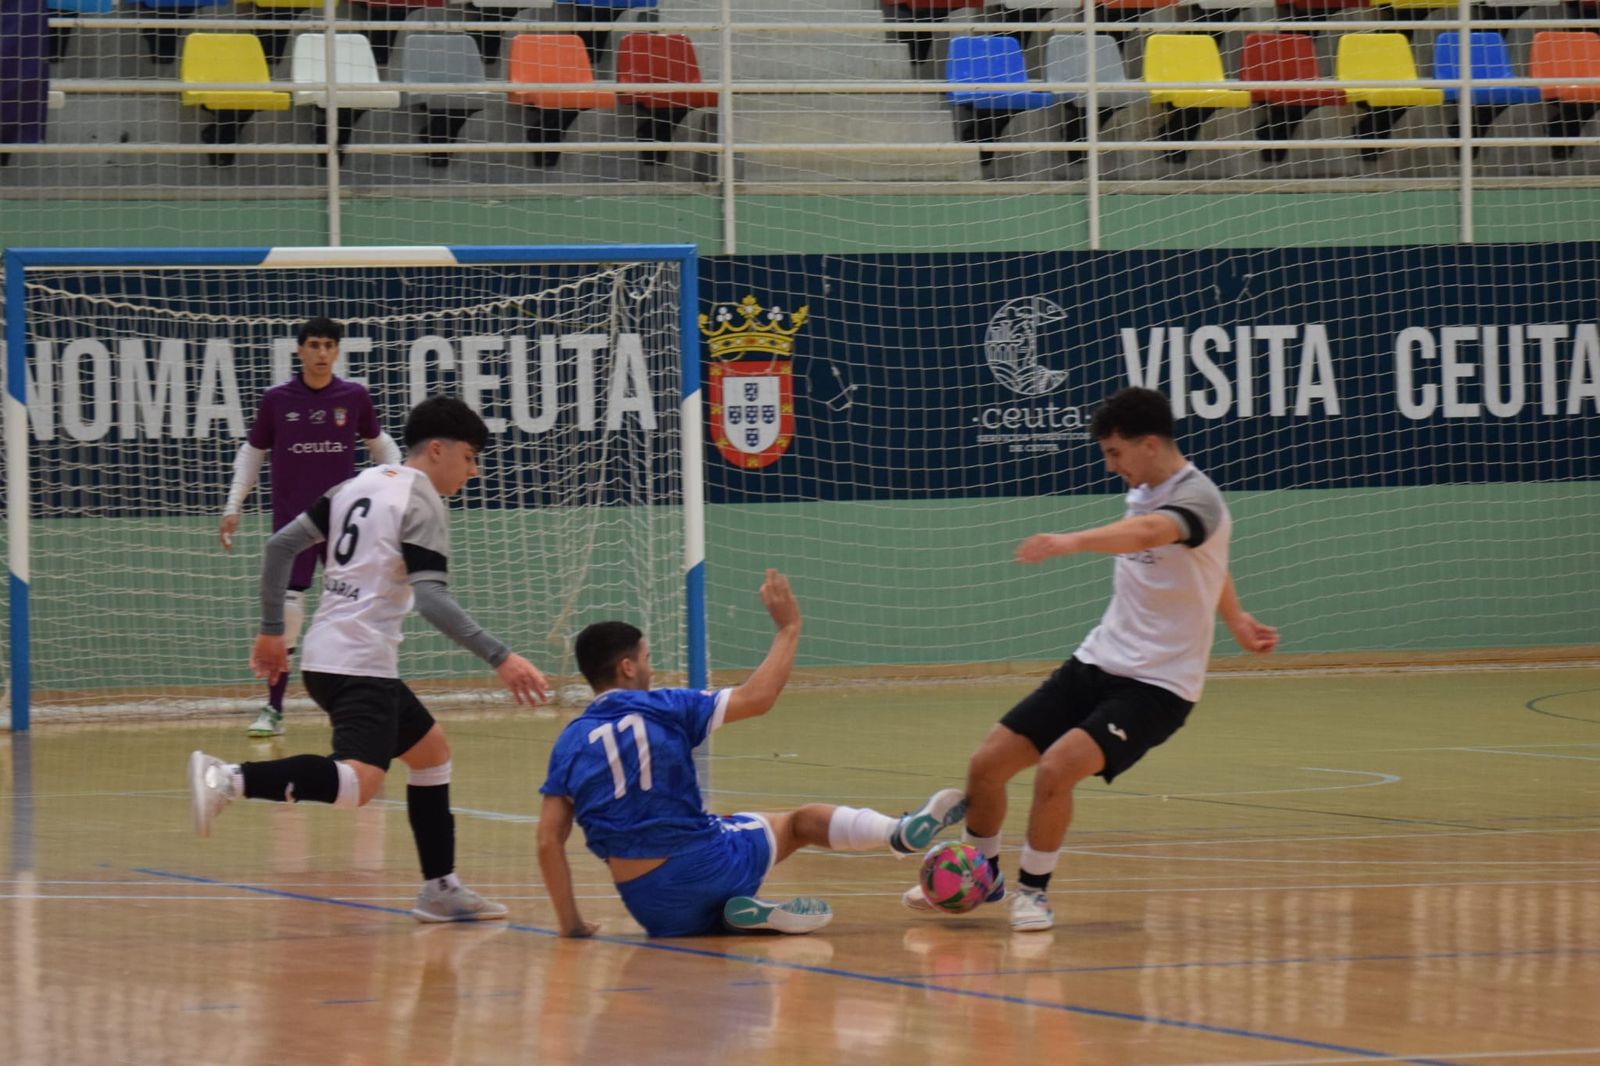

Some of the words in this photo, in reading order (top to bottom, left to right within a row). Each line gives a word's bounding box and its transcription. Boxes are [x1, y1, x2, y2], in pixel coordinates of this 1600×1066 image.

[408, 333, 657, 433] CEUTA
[1121, 324, 1341, 419] VISITA
[1396, 323, 1600, 420] CEUTA
[334, 497, 372, 566] 6
[588, 712, 653, 800] 11
